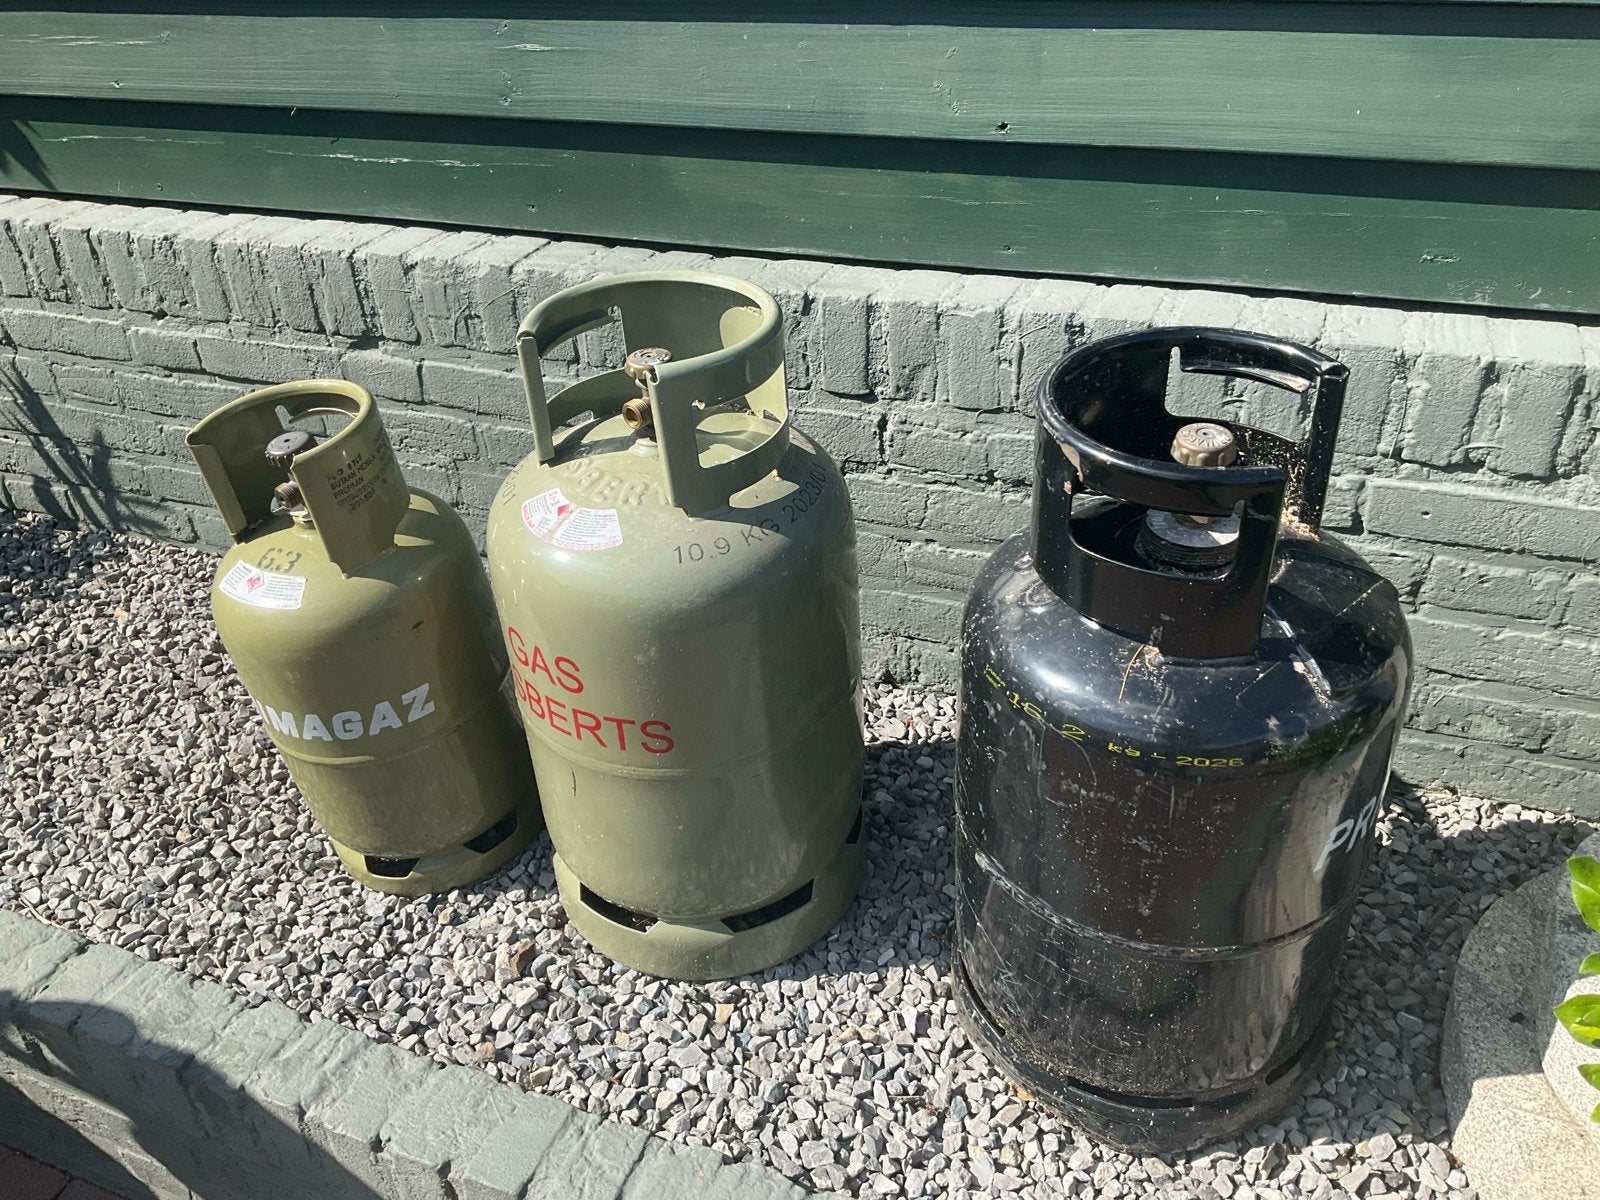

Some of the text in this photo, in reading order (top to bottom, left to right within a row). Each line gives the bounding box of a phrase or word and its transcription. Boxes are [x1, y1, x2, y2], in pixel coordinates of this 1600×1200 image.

[673, 462, 828, 564] 10.9 KG 2023/01
[508, 626, 584, 694] GAS
[1175, 756, 1245, 768] 2026
